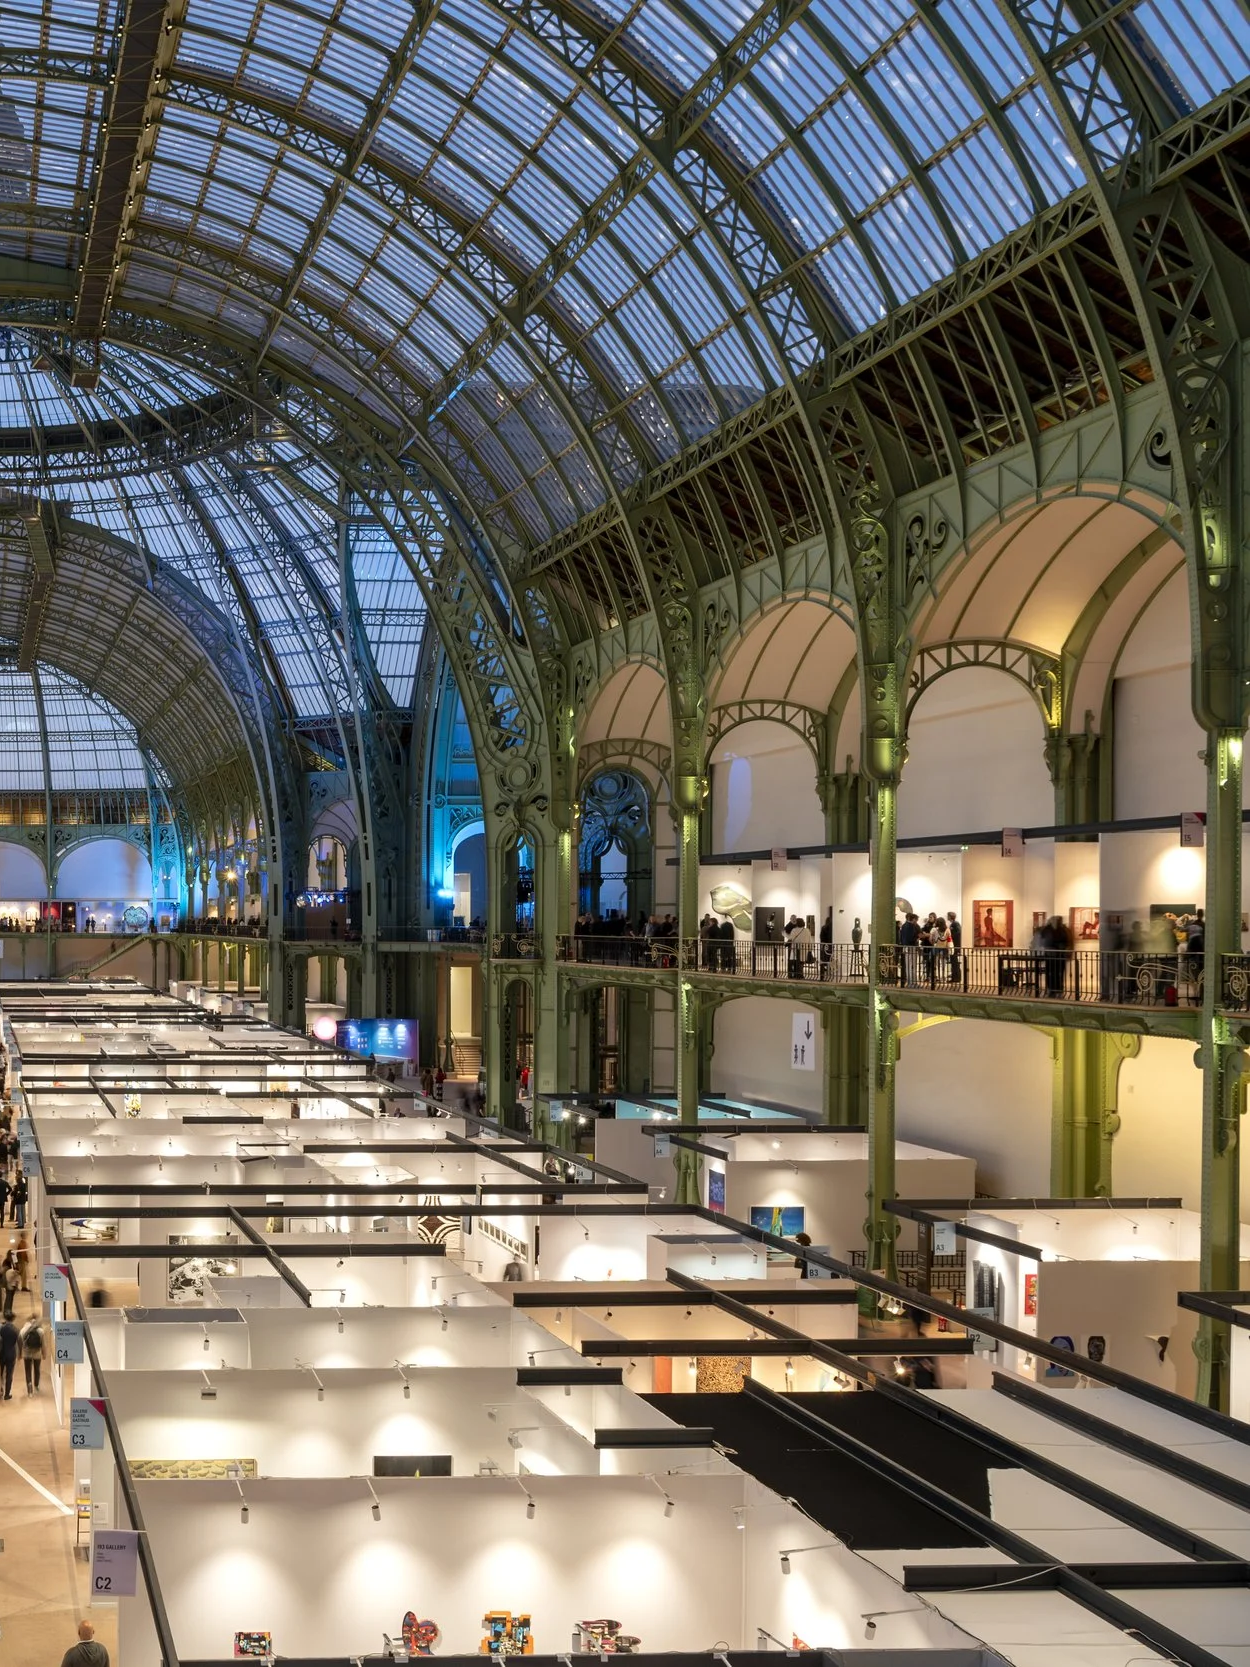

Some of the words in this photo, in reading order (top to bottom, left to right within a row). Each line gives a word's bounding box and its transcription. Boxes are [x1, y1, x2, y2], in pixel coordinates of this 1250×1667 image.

[44, 1290, 54, 1298] C5
[57, 1349, 68, 1358] C4
[72, 1434, 85, 1445] C3
[95, 1576, 112, 1590] C2
